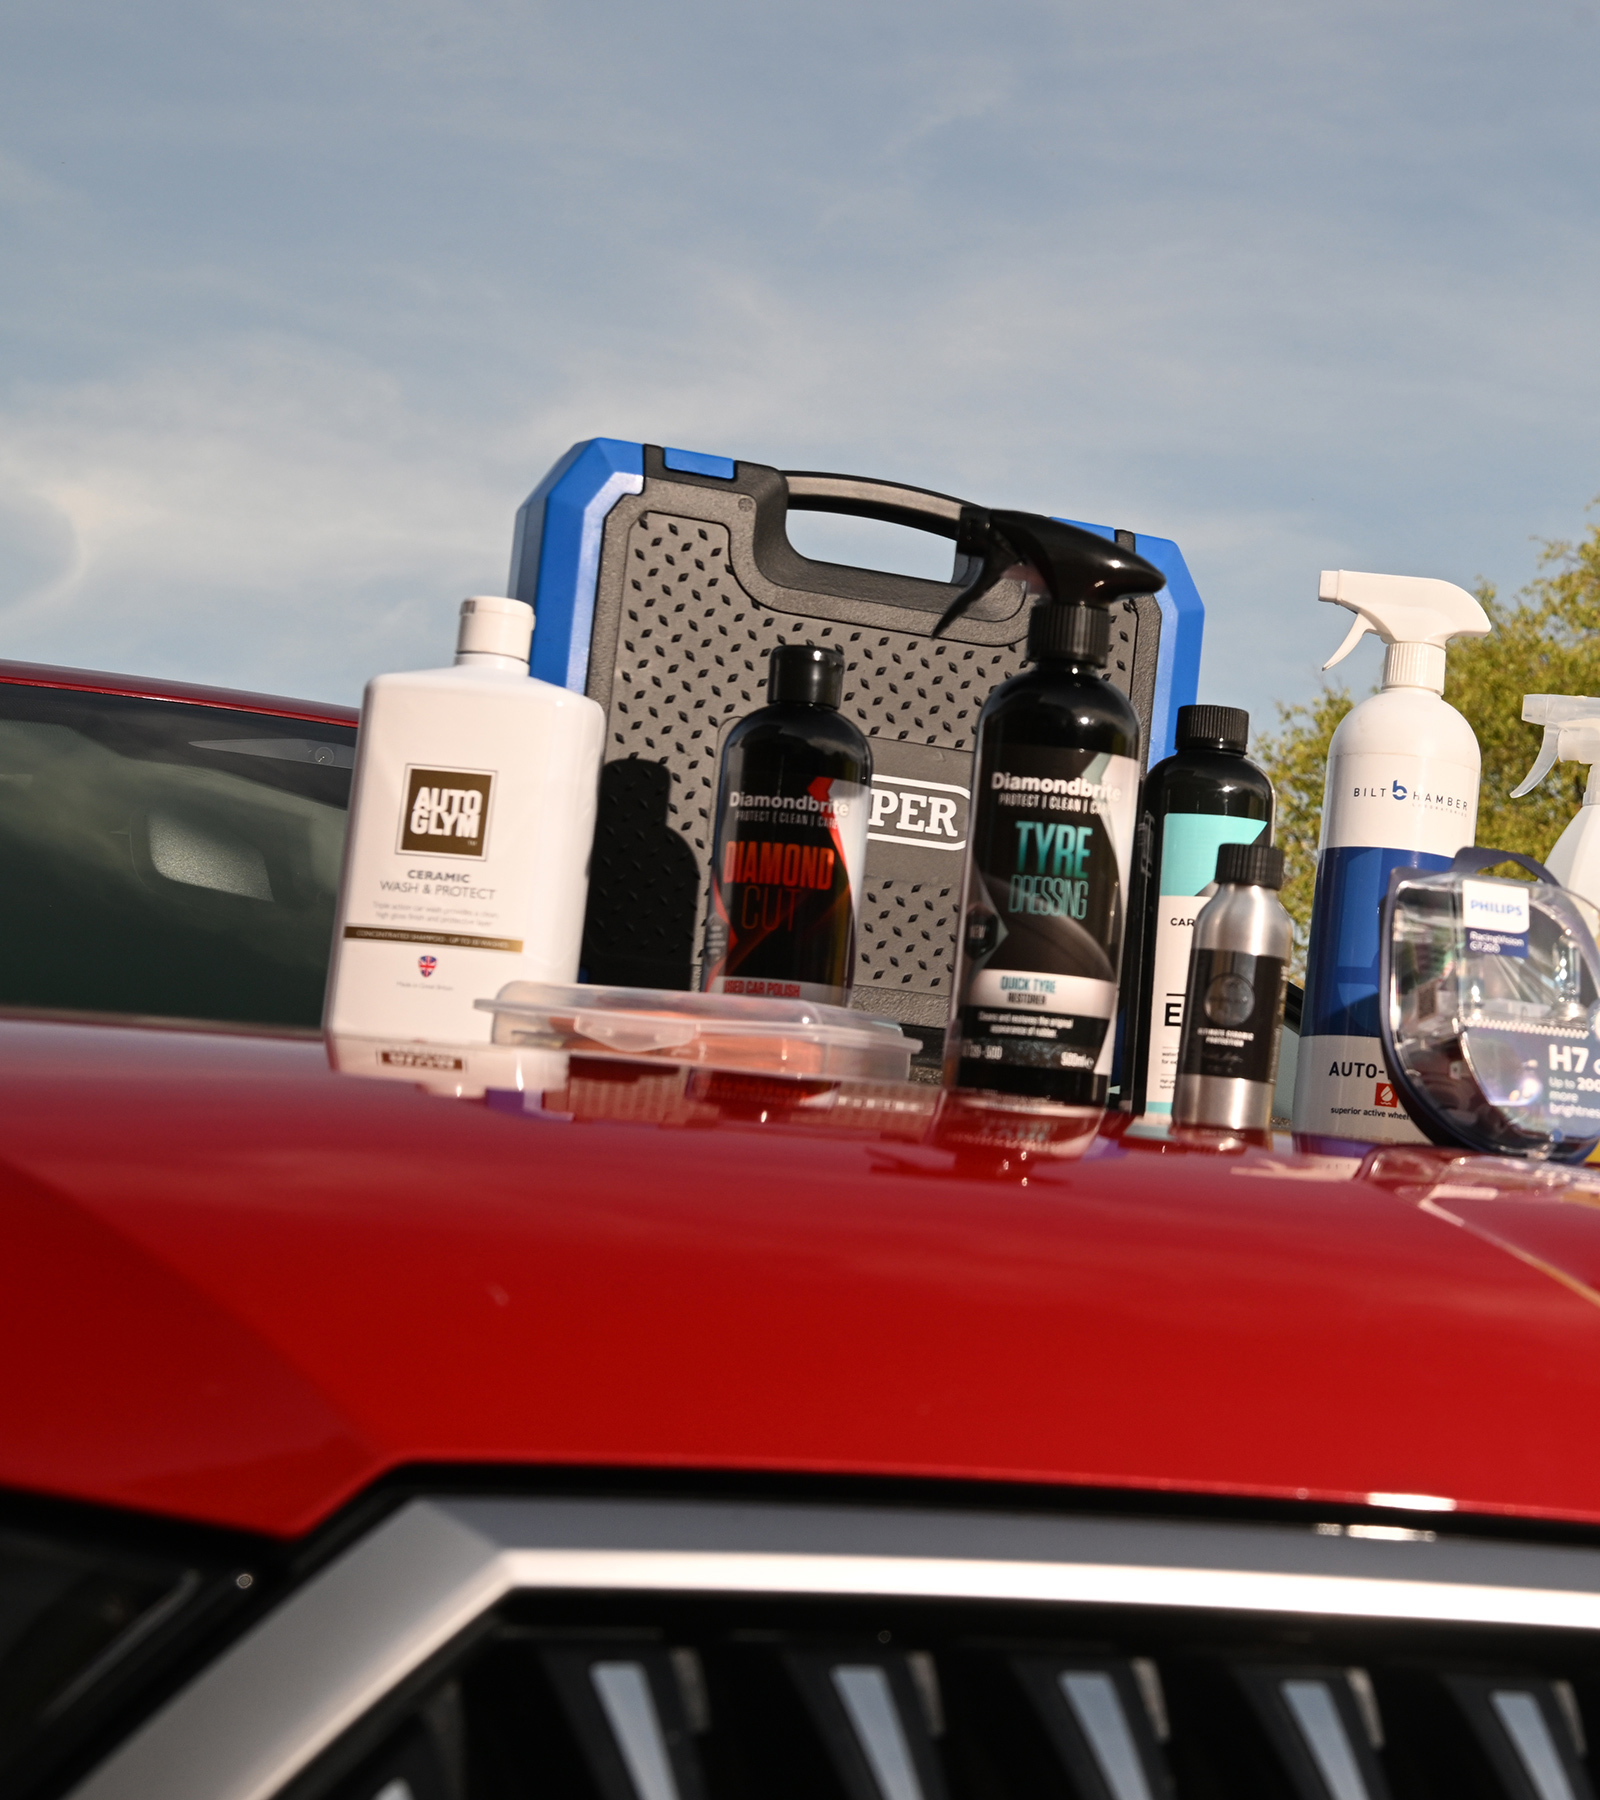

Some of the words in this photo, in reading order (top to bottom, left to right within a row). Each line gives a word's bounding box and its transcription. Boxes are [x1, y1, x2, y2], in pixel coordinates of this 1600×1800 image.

[991, 771, 1123, 801] Diamondbrite
[412, 786, 483, 814] AUTO
[729, 791, 850, 818] Diamondbrite
[998, 792, 1041, 809] PROTECT
[1049, 796, 1082, 812] CLEAN
[1353, 787, 1386, 798] BILT
[1412, 791, 1468, 811] HAMBER
[734, 809, 770, 822] PROTECT
[778, 812, 808, 826] CLEAN
[868, 788, 958, 837] PER
[410, 809, 481, 838] GLYM
[1015, 820, 1093, 879] TYRE
[723, 840, 835, 890] DIAMOND
[407, 869, 470, 883] CERAMIC
[380, 881, 419, 894] WASH
[422, 883, 431, 894] &
[435, 885, 496, 900] PROTECT
[1008, 874, 1089, 920] DRESSING
[741, 885, 799, 932] CUT
[1471, 900, 1523, 917] PHILIPS
[1170, 917, 1195, 927] CAR
[723, 979, 745, 994] USED
[746, 981, 766, 995] CAR
[767, 983, 800, 997] POLISH
[1001, 975, 1030, 992] QUICK
[1033, 979, 1056, 994] TYRE
[1007, 992, 1047, 1005] RESTORER
[1165, 1003, 1182, 1027] E
[1549, 1043, 1589, 1073] H7
[1329, 1061, 1385, 1079] AUTO-
[1549, 1077, 1564, 1090] Up
[1564, 1078, 1576, 1090] to
[1549, 1090, 1579, 1103] more
[1331, 1107, 1361, 1116] superior
[1363, 1109, 1386, 1118] active
[1388, 1112, 1410, 1120] wheel
